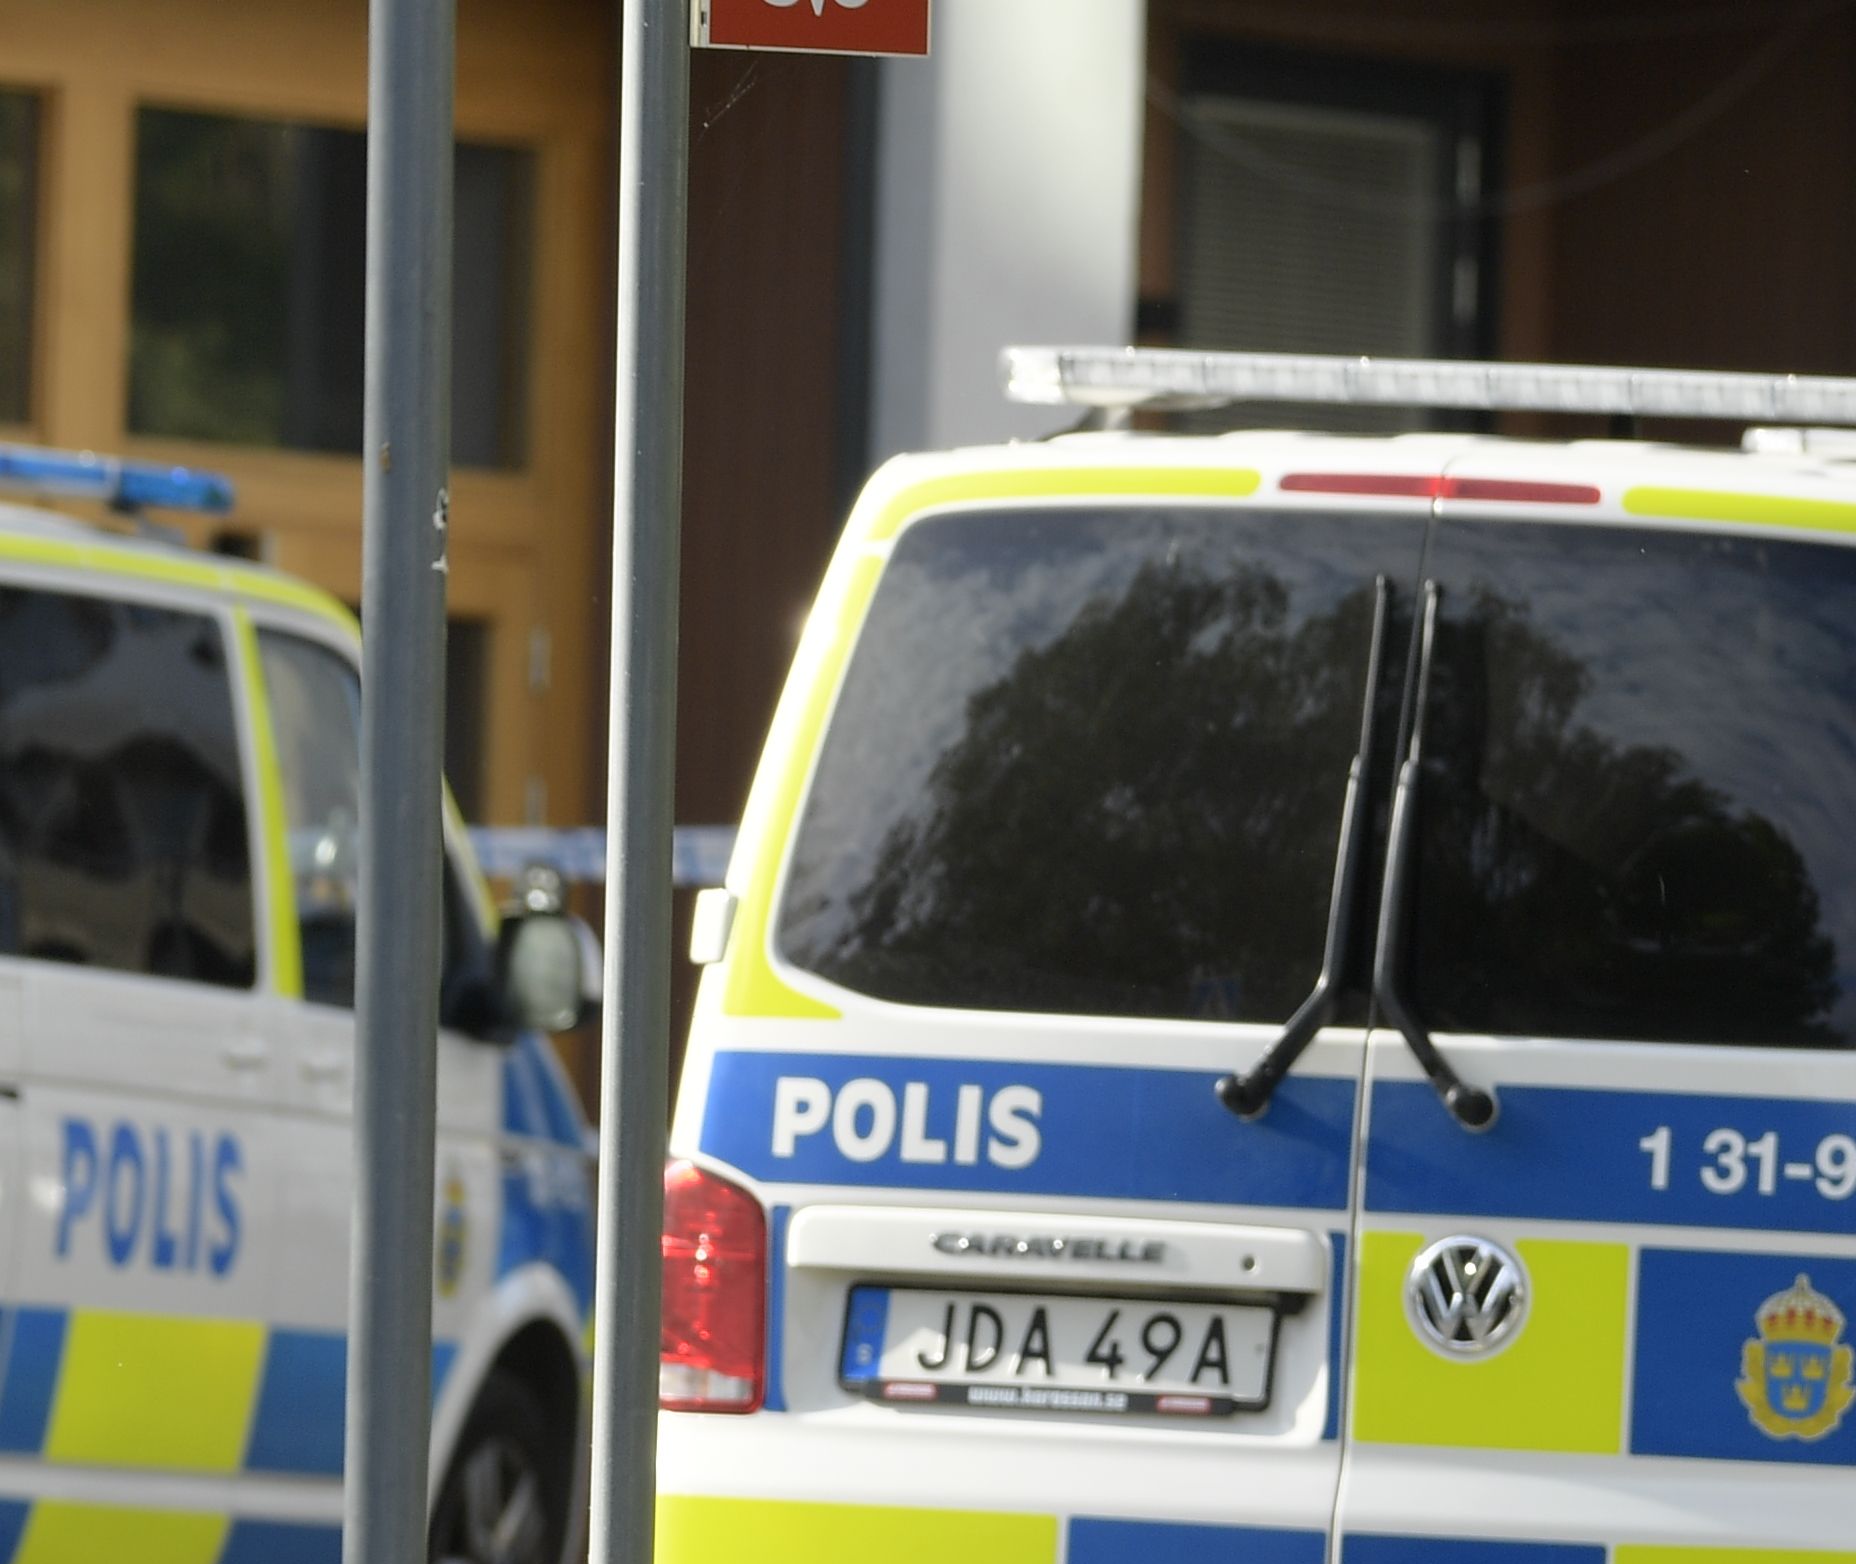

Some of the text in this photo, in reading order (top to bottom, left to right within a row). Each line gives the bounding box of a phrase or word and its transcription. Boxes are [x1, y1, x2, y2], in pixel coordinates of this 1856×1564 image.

[772, 1075, 1043, 1170] POLIS
[1639, 1126, 1671, 1190] 1
[54, 1114, 246, 1278] POLIS
[930, 1232, 1169, 1263] CARAVELLE
[917, 1303, 1230, 1385] JDA 49A
